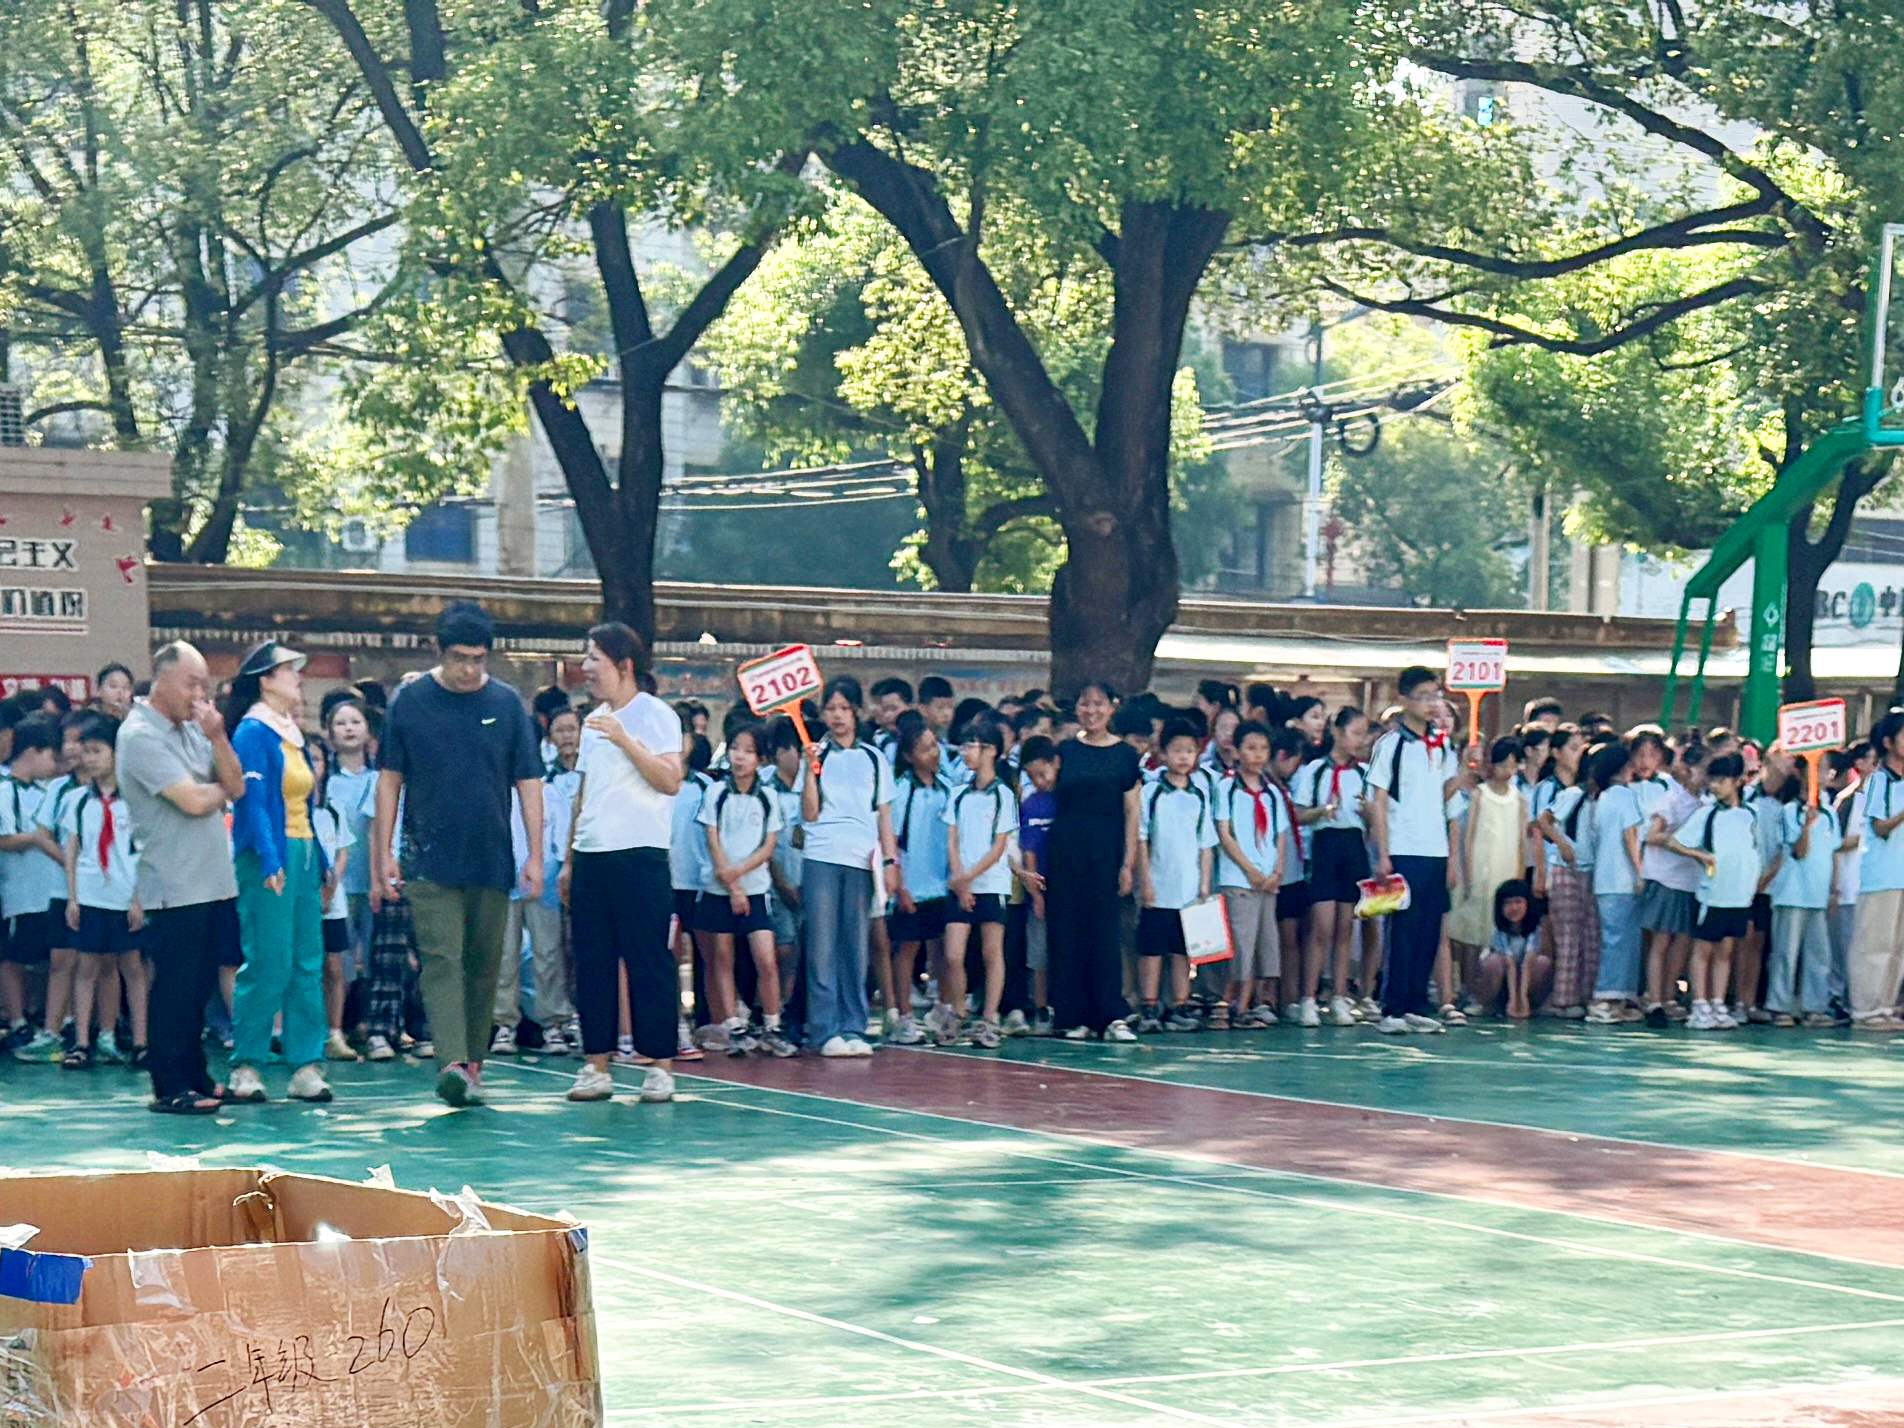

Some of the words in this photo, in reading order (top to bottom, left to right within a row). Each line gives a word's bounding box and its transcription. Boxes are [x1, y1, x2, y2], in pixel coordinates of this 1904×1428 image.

[1452, 660, 1501, 681] 2101
[751, 666, 813, 704] 2102
[1786, 719, 1840, 745] 2201
